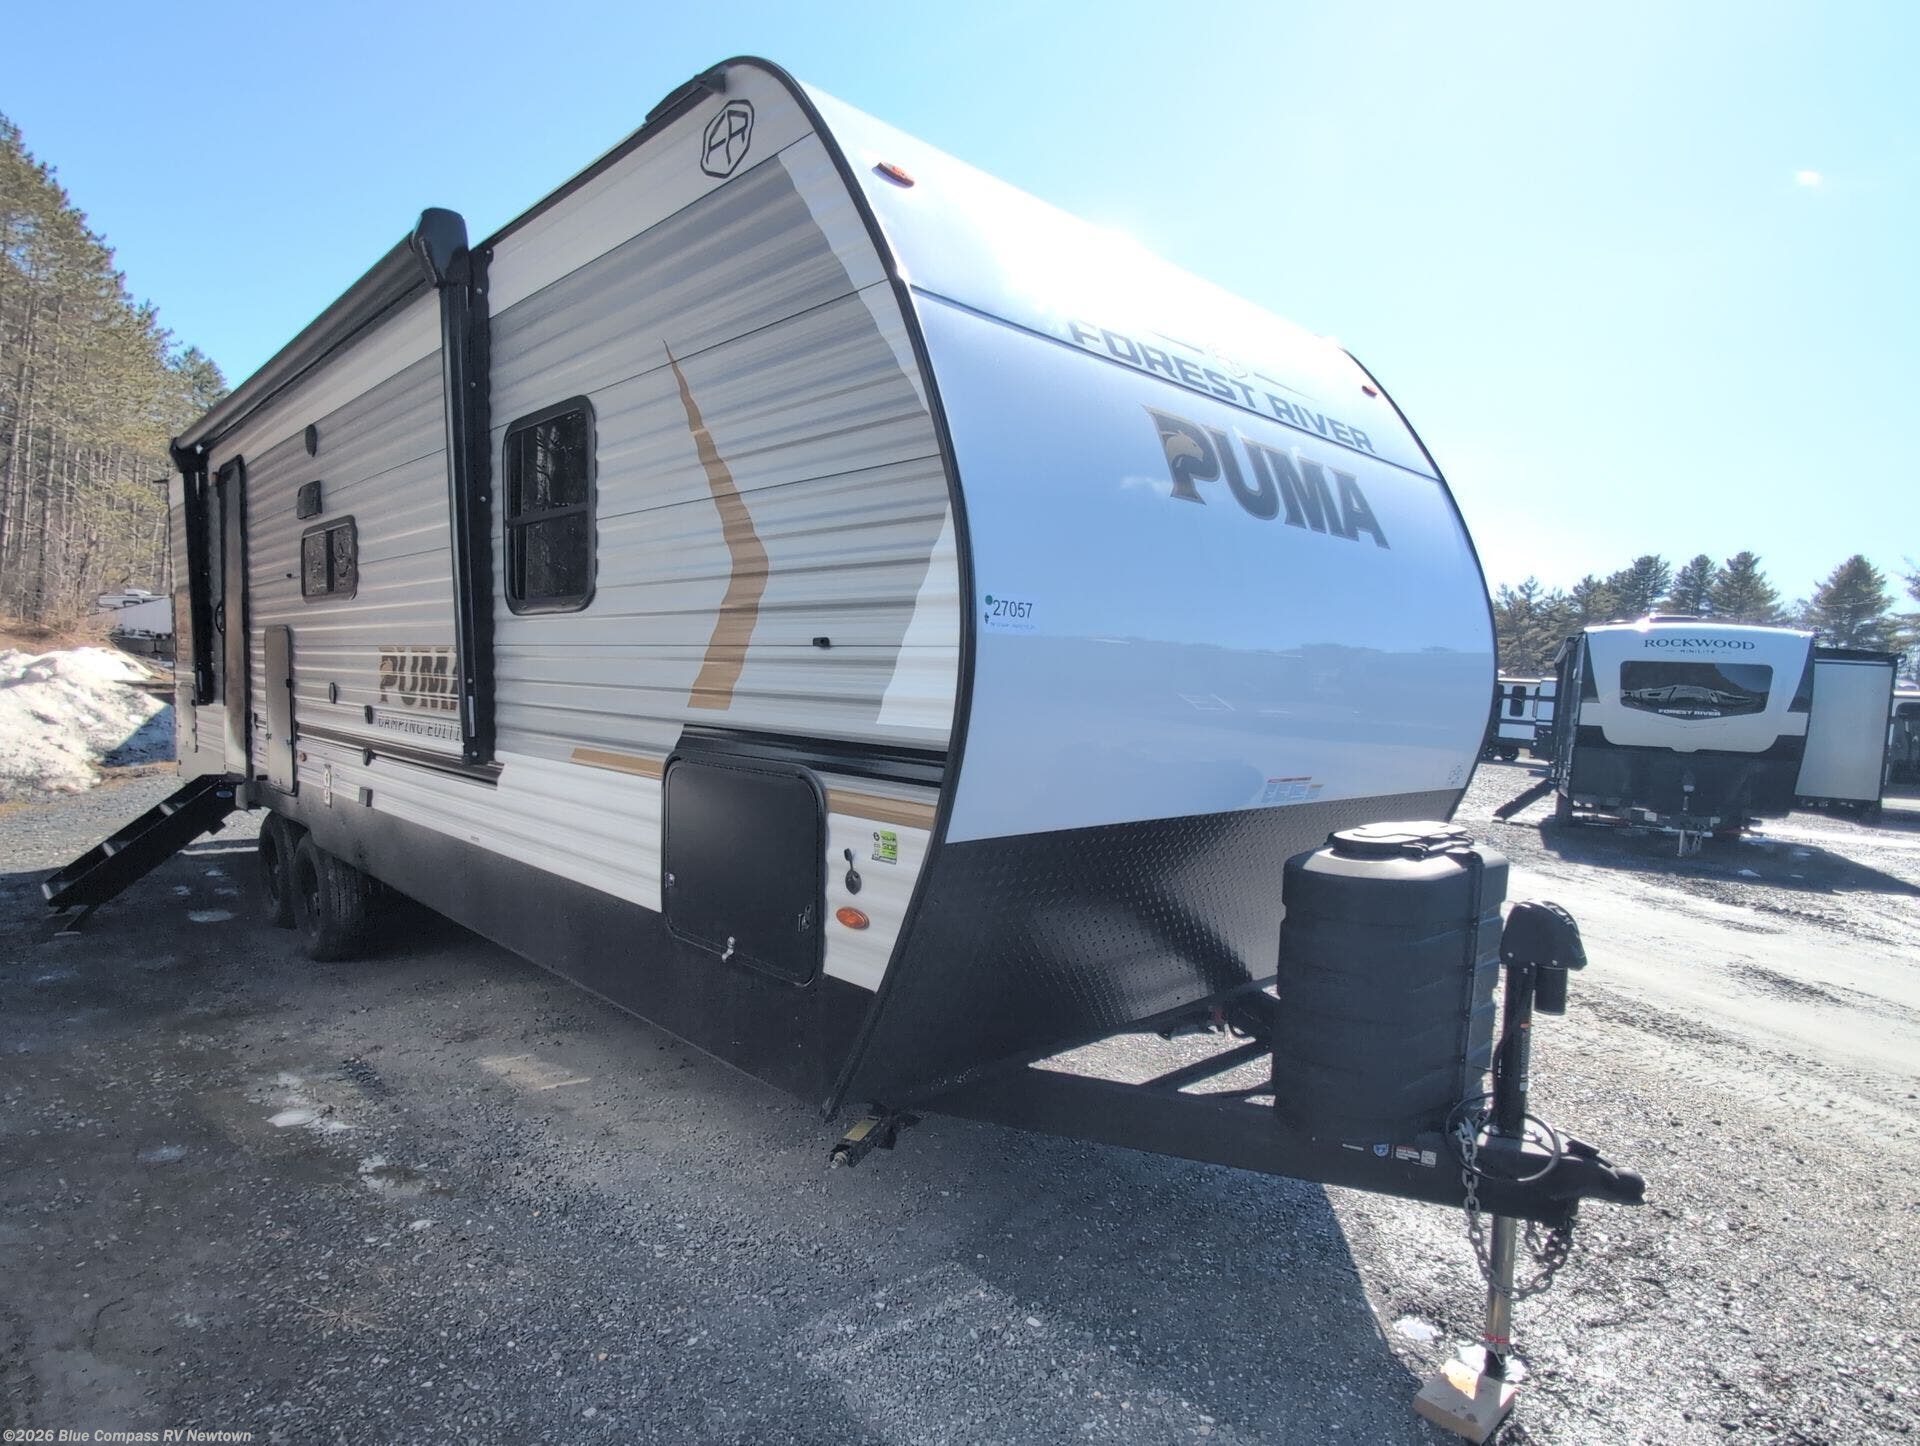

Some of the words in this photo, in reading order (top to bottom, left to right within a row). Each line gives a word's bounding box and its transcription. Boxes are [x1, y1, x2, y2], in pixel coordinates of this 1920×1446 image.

[1067, 320, 1257, 408] FOREST
[1264, 391, 1376, 454] RIVER
[1137, 402, 1391, 550] PUMA
[992, 599, 1033, 619] 27057
[1643, 638, 1756, 650] ROCKWOOD
[1657, 708, 1693, 716] FOREST
[1694, 709, 1721, 717] RIVER
[378, 717, 423, 735] CAMPING
[426, 724, 461, 741] EDITI
